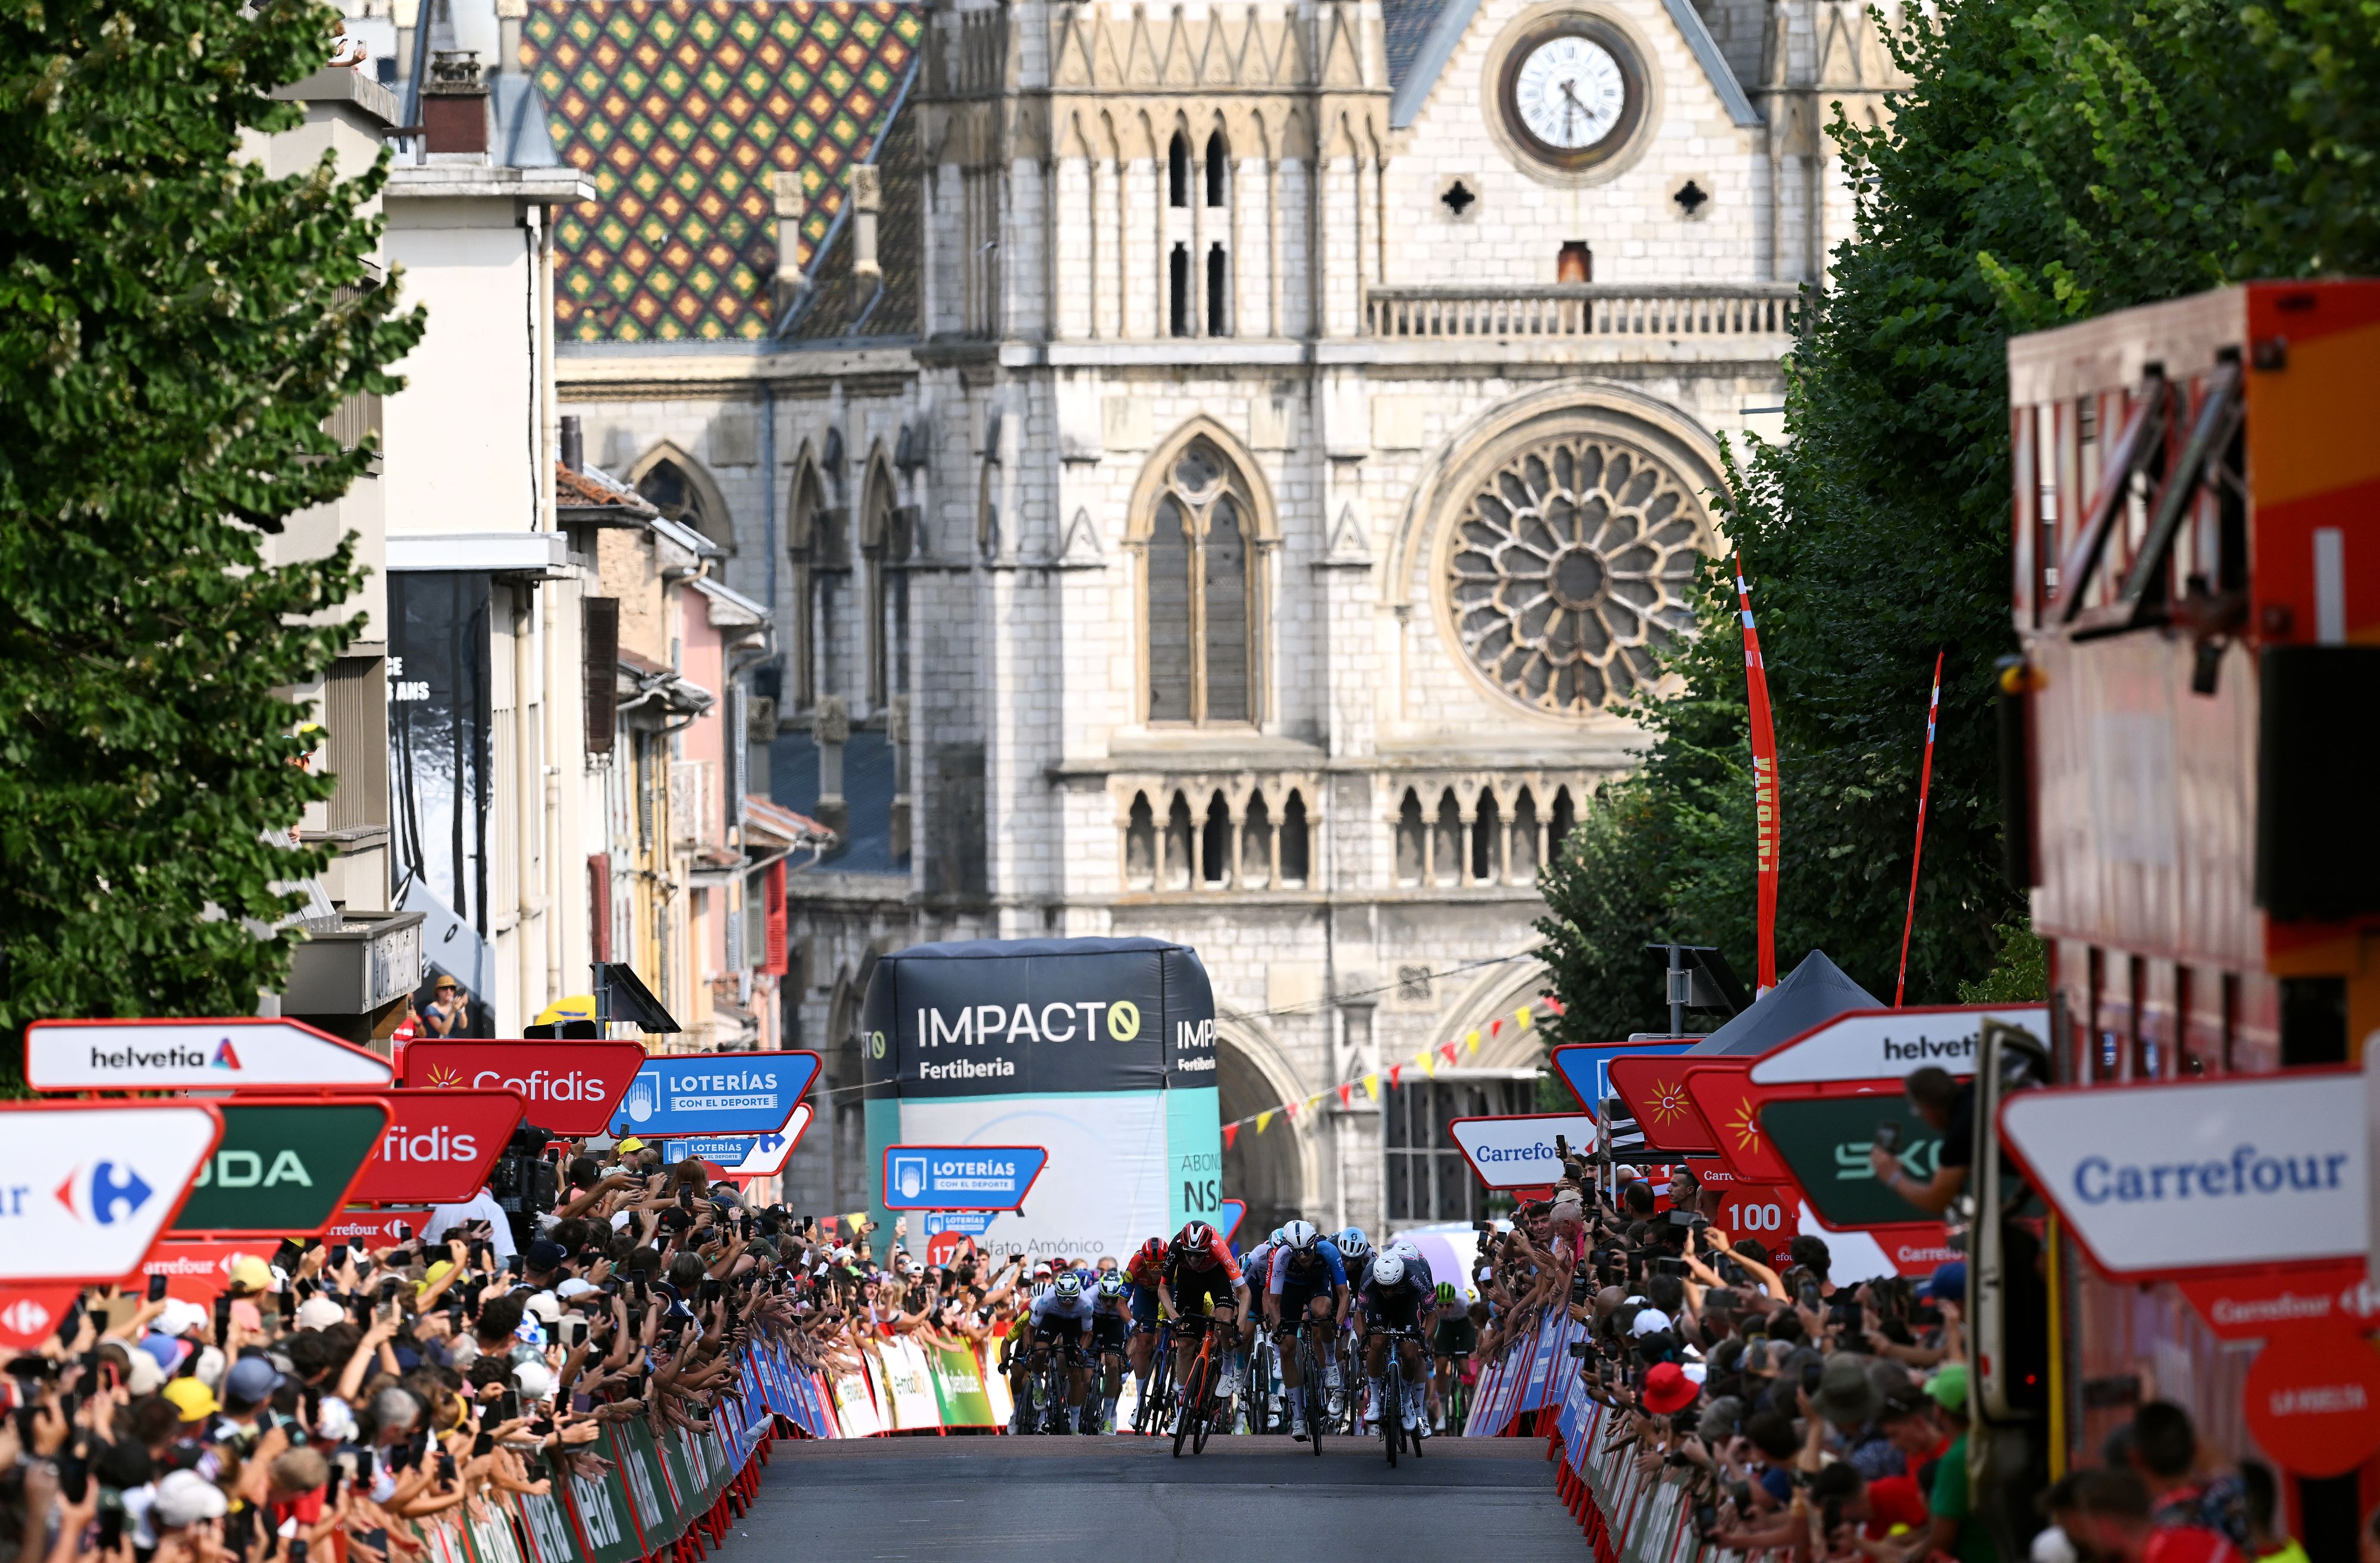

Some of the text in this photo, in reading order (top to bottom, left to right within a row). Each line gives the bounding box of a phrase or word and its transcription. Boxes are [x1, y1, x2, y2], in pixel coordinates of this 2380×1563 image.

[396, 681, 430, 701] ANS
[91, 1045, 203, 1069] helvetia
[1884, 1036, 1981, 1061] helveti
[919, 1057, 1014, 1079] Fertiberia
[474, 1070, 605, 1101] Cofidis
[670, 1071, 778, 1092] LOTERÍAS
[721, 1098, 769, 1106] DEPORTE
[372, 1126, 478, 1162] fidis
[691, 1142, 741, 1152] LOTERÍAS
[1476, 1142, 1576, 1162] Carrefor
[933, 1160, 1016, 1176] LOTERÍAS
[2074, 1145, 2347, 1204] Carrefour
[1728, 1204, 1781, 1230] 100
[326, 1223, 379, 1235] rrefour
[933, 1245, 956, 1266] 17
[983, 1237, 1104, 1256] lfato Amónico
[1221, 1252, 1238, 1273] INEOS
[1410, 1275, 1427, 1293] Alpecin
